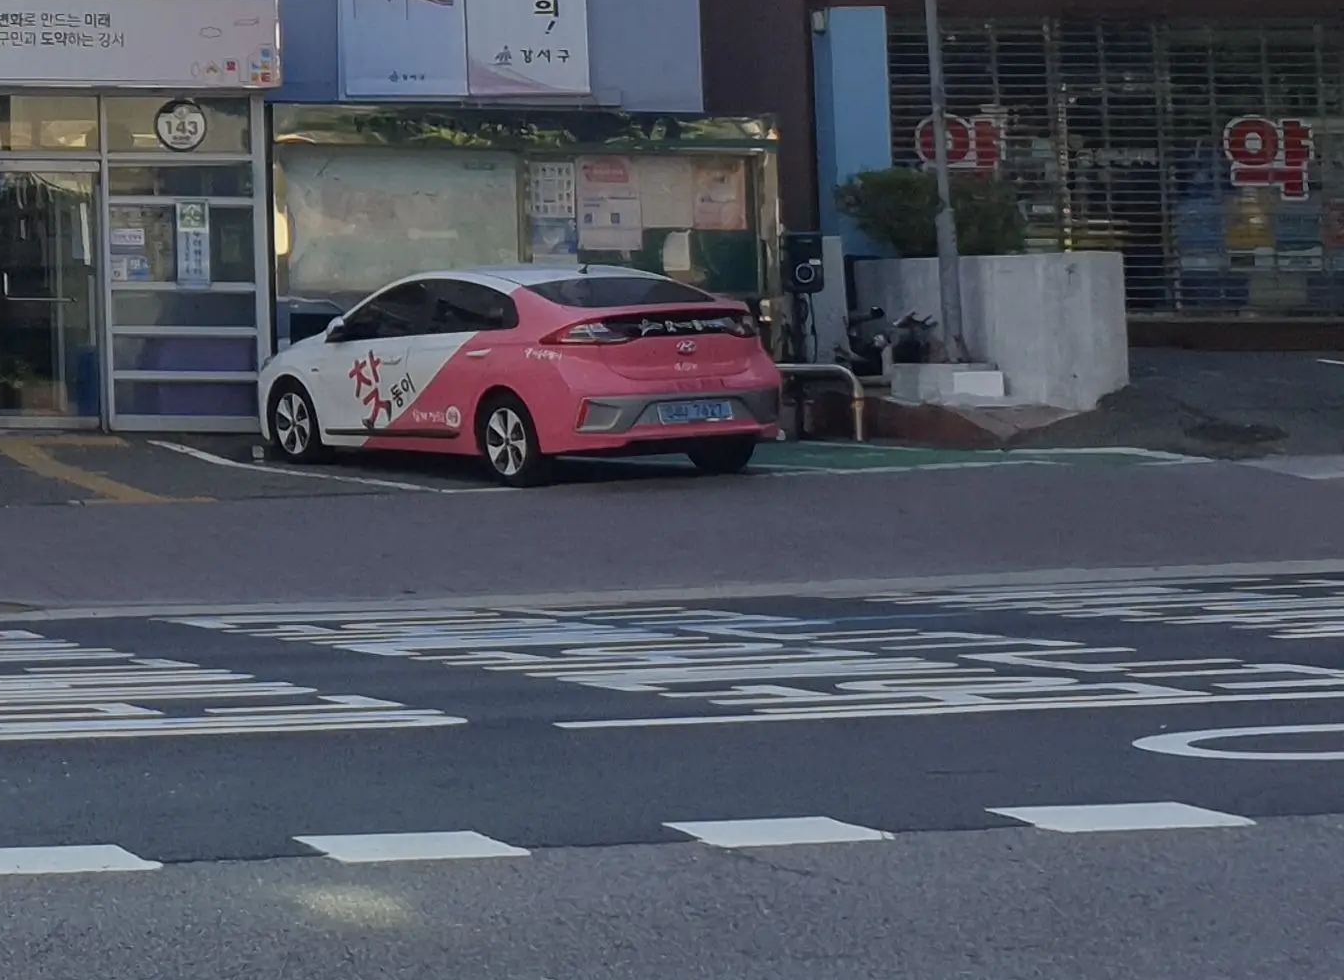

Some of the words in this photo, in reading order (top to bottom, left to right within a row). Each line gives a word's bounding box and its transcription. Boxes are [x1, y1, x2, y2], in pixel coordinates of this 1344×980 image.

[40, 12, 81, 28] 만드는
[84, 12, 111, 28] 미래
[40, 32, 94, 48] 도약하는
[98, 32, 125, 49] 강서
[520, 48, 571, 64] 강서구
[165, 120, 198, 136] 143
[1223, 115, 1313, 201] 약
